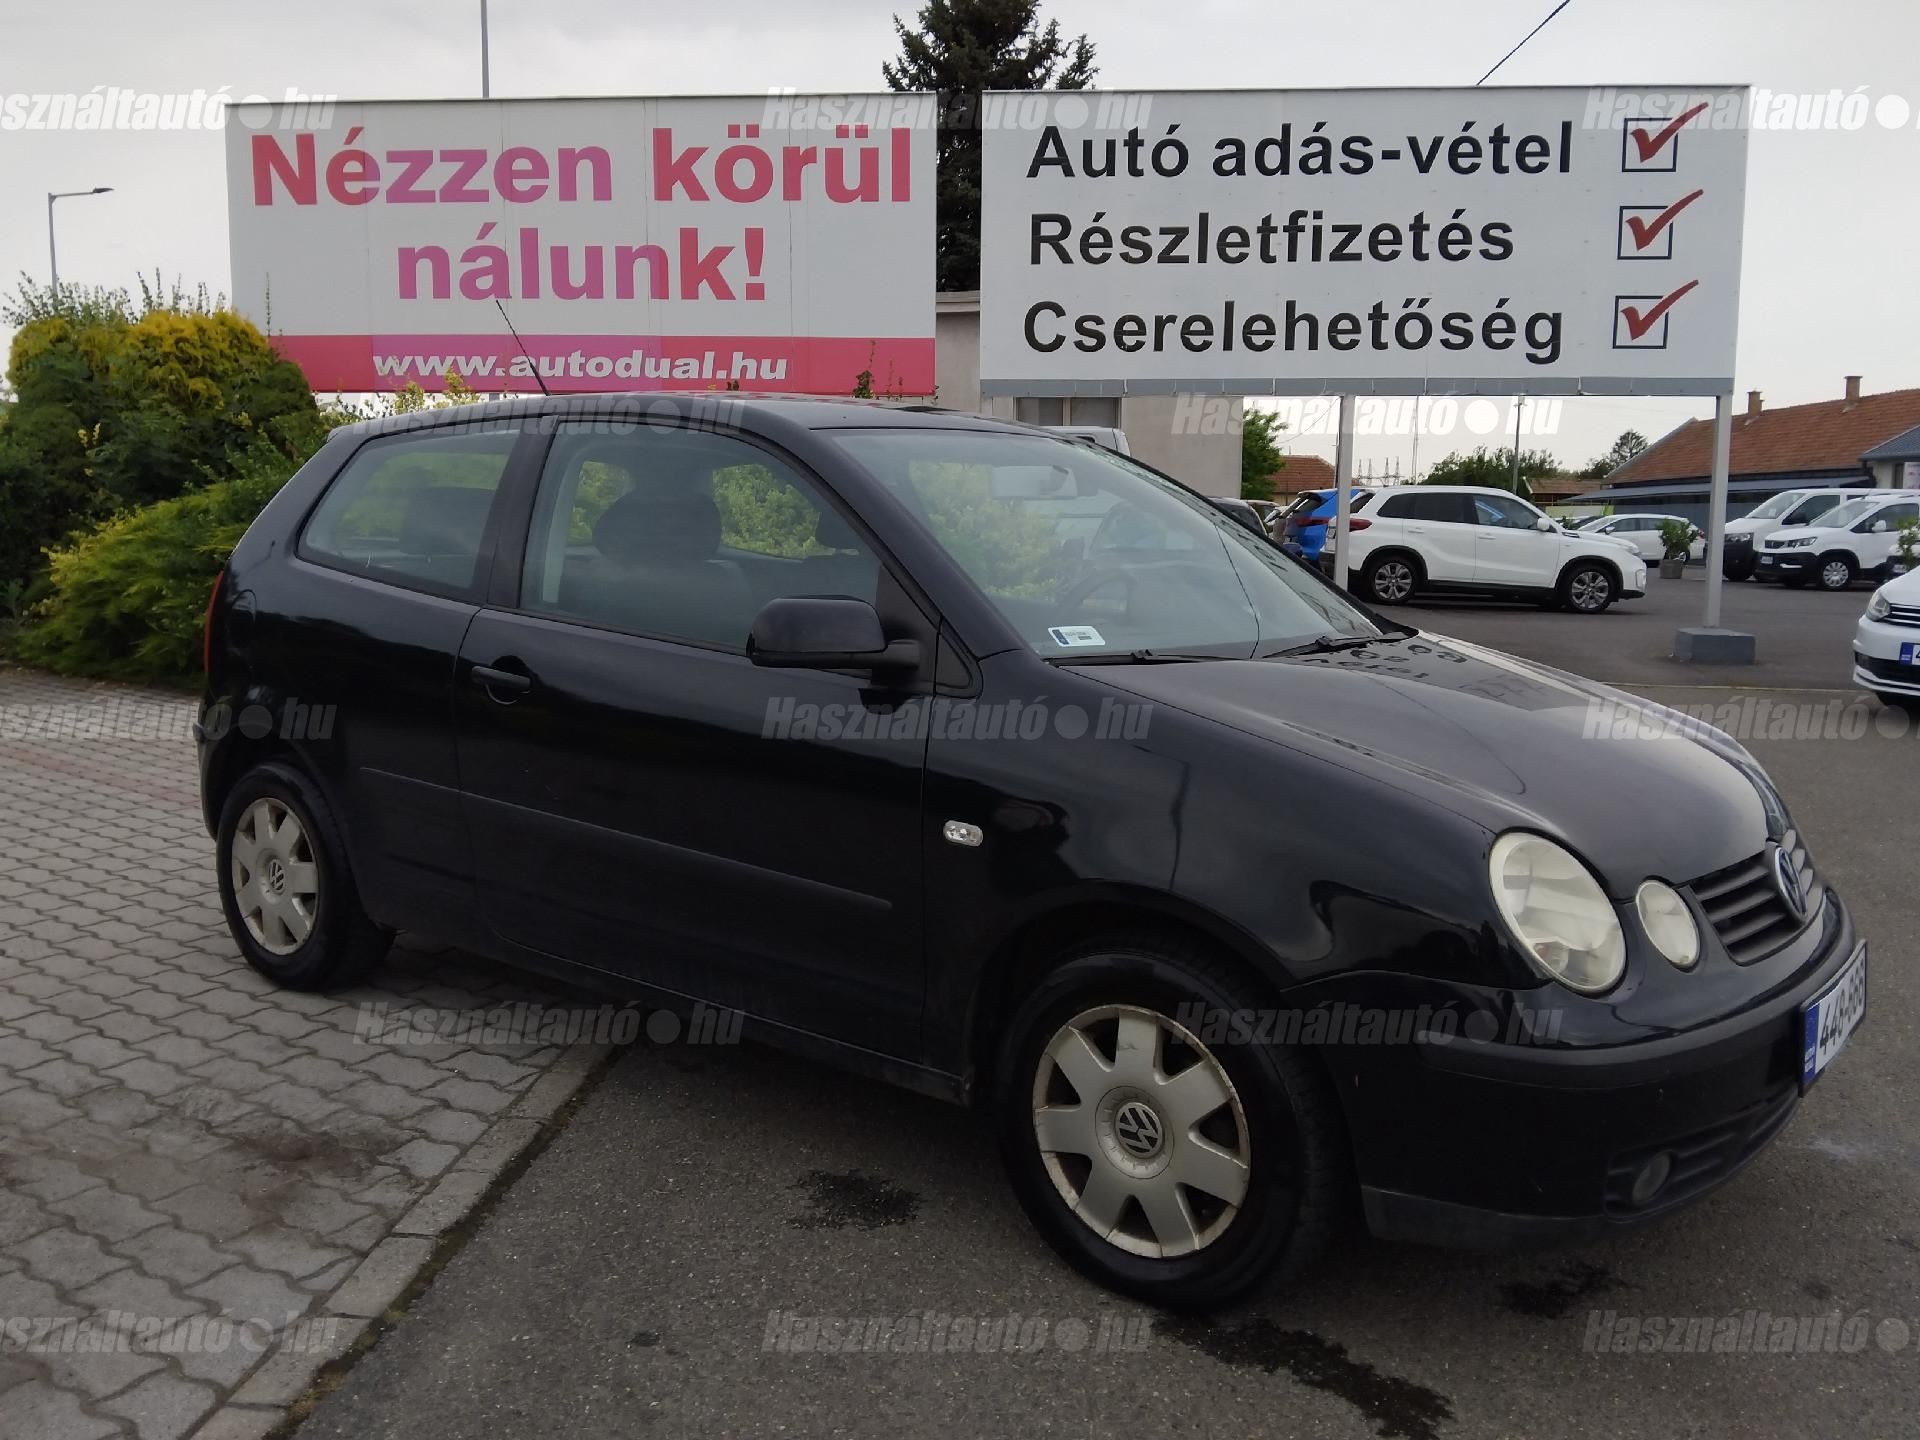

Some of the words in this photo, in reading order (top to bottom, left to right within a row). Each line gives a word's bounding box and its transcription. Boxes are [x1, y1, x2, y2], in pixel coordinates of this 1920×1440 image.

[253, 128, 611, 206] Nézzen
[654, 125, 911, 204] körül
[1026, 124, 1189, 179] Autó
[1213, 120, 1573, 177] adás-vétel
[399, 223, 765, 301] nálunk!
[1030, 208, 1514, 265] Részletfizetés
[1024, 298, 1562, 365] Cserelehetőség
[373, 349, 787, 380] www.autodual.hu
